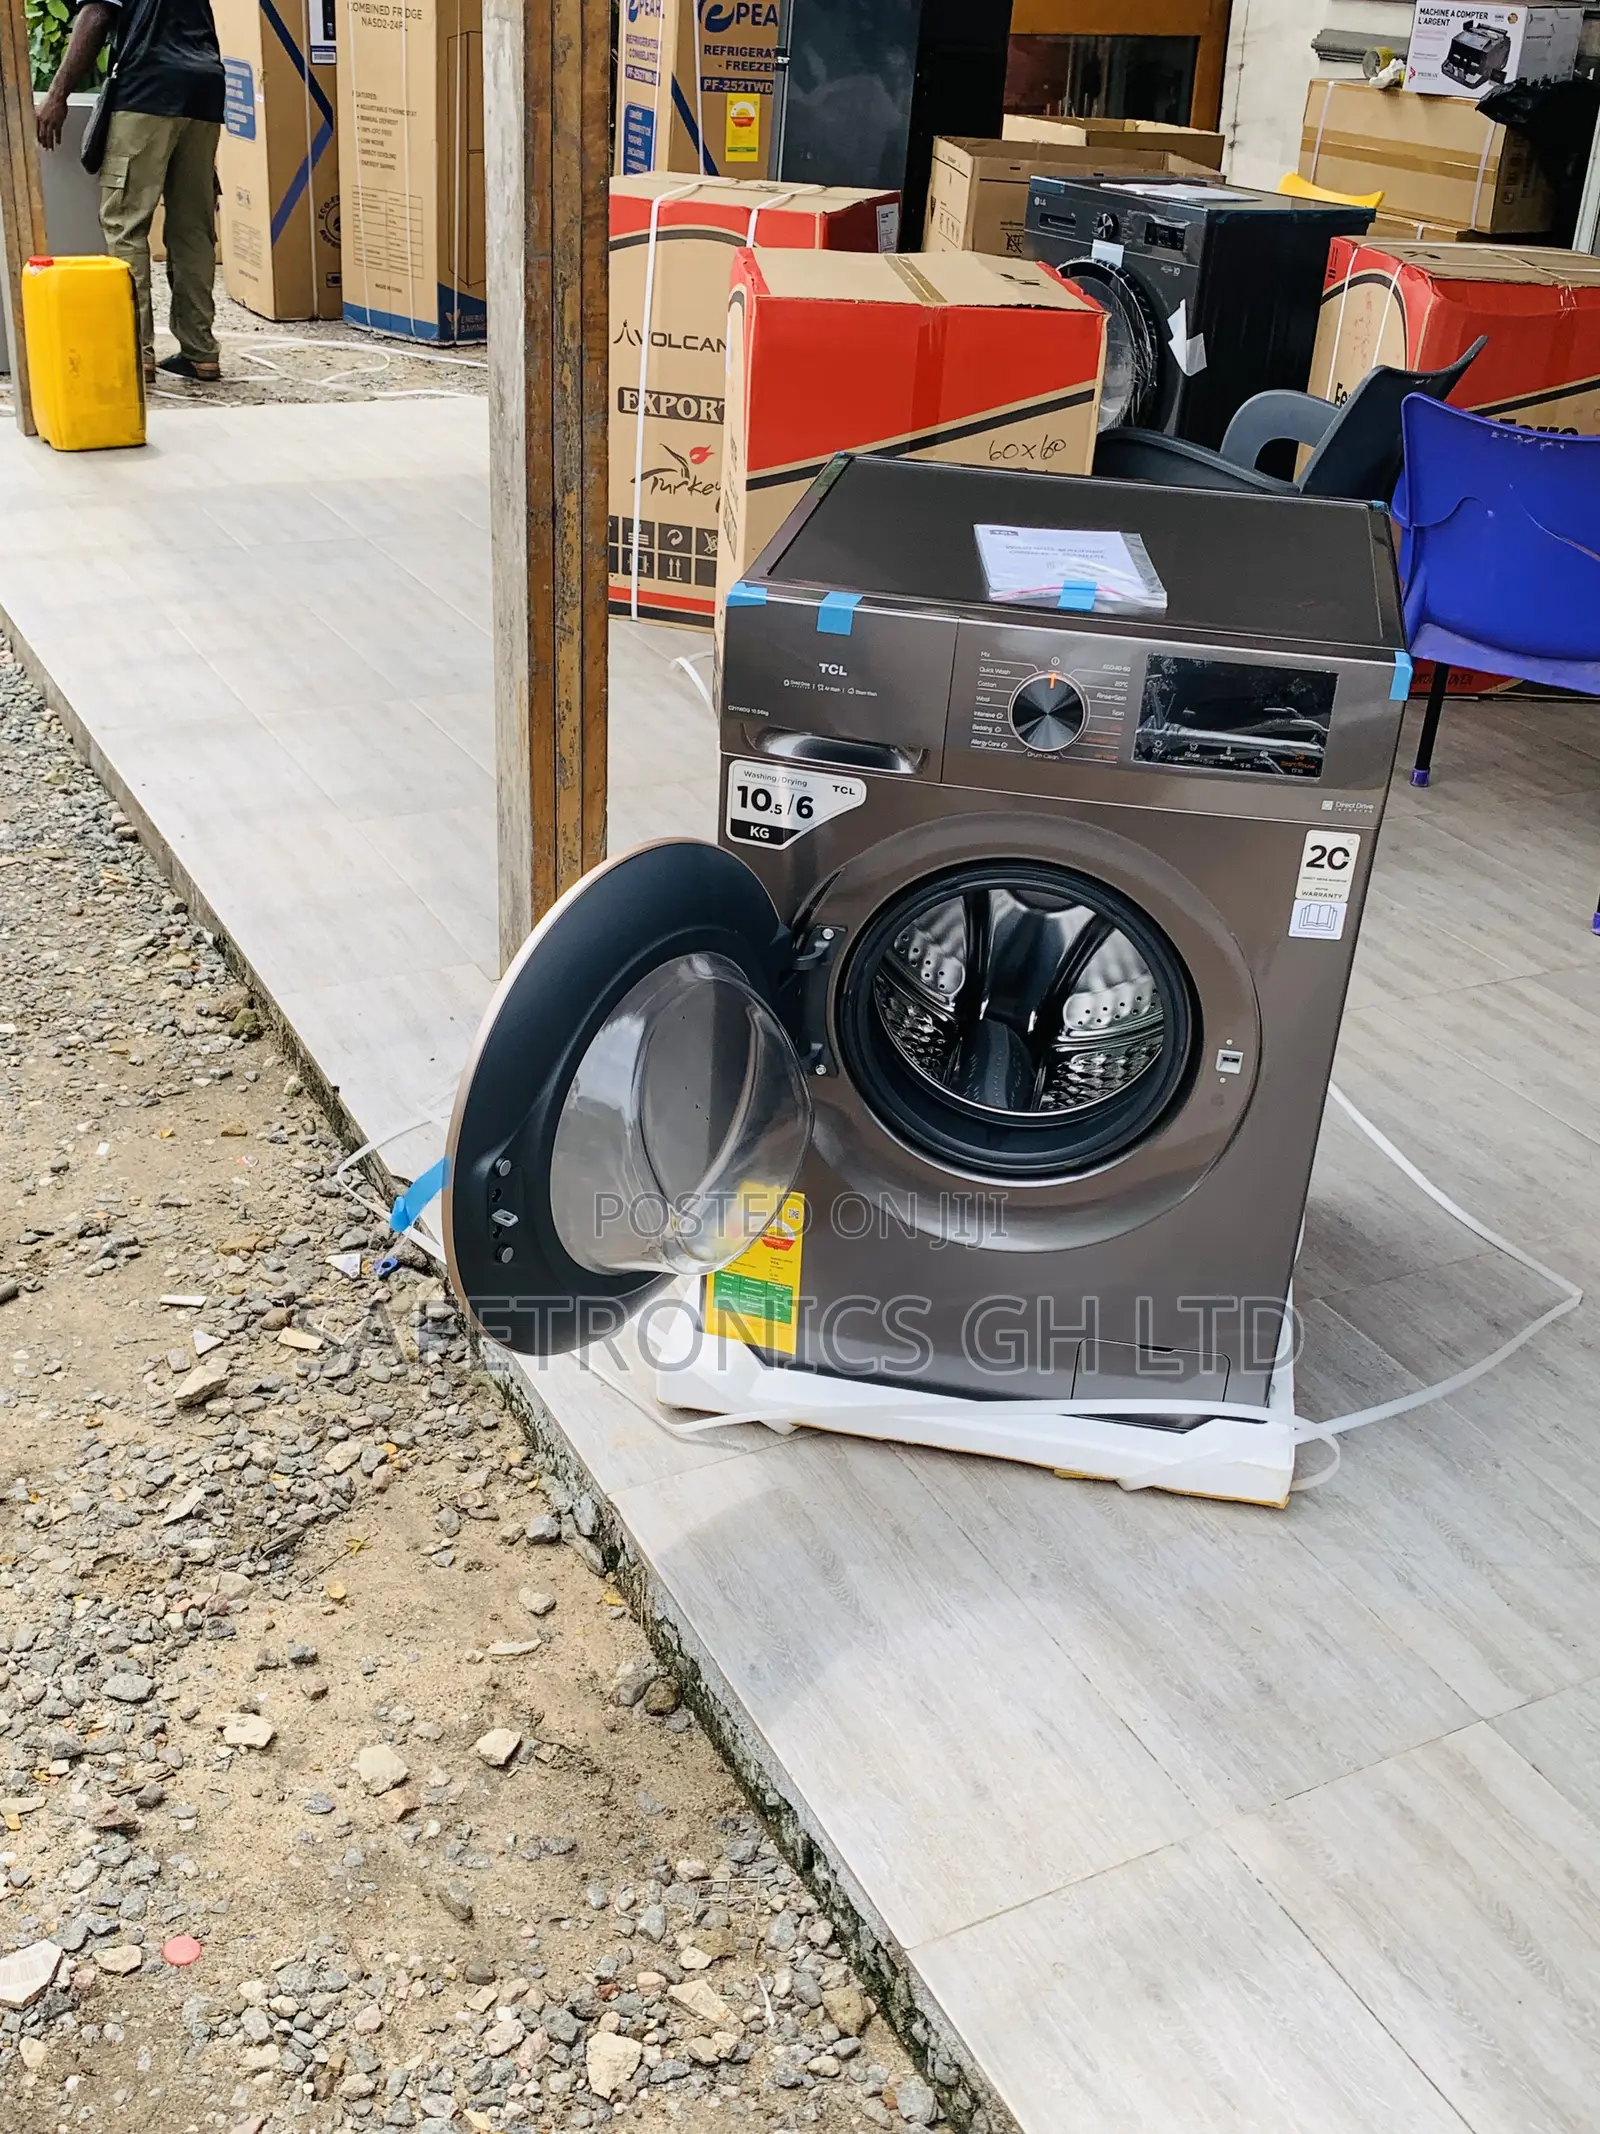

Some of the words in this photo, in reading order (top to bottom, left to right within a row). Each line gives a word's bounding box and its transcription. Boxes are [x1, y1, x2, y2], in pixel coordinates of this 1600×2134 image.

[392, 6, 423, 20] FRDGE
[1419, 7, 1450, 18] MACHINE
[1450, 9, 1456, 17] A
[1456, 9, 1489, 20] COMPTER
[1418, 17, 1451, 27] L'ARGENT
[818, 662, 848, 677] TCL
[1027, 751, 1043, 759] Drum
[832, 784, 856, 796] TCL
[749, 825, 770, 839] KG
[1301, 890, 1343, 899] WARRANTY
